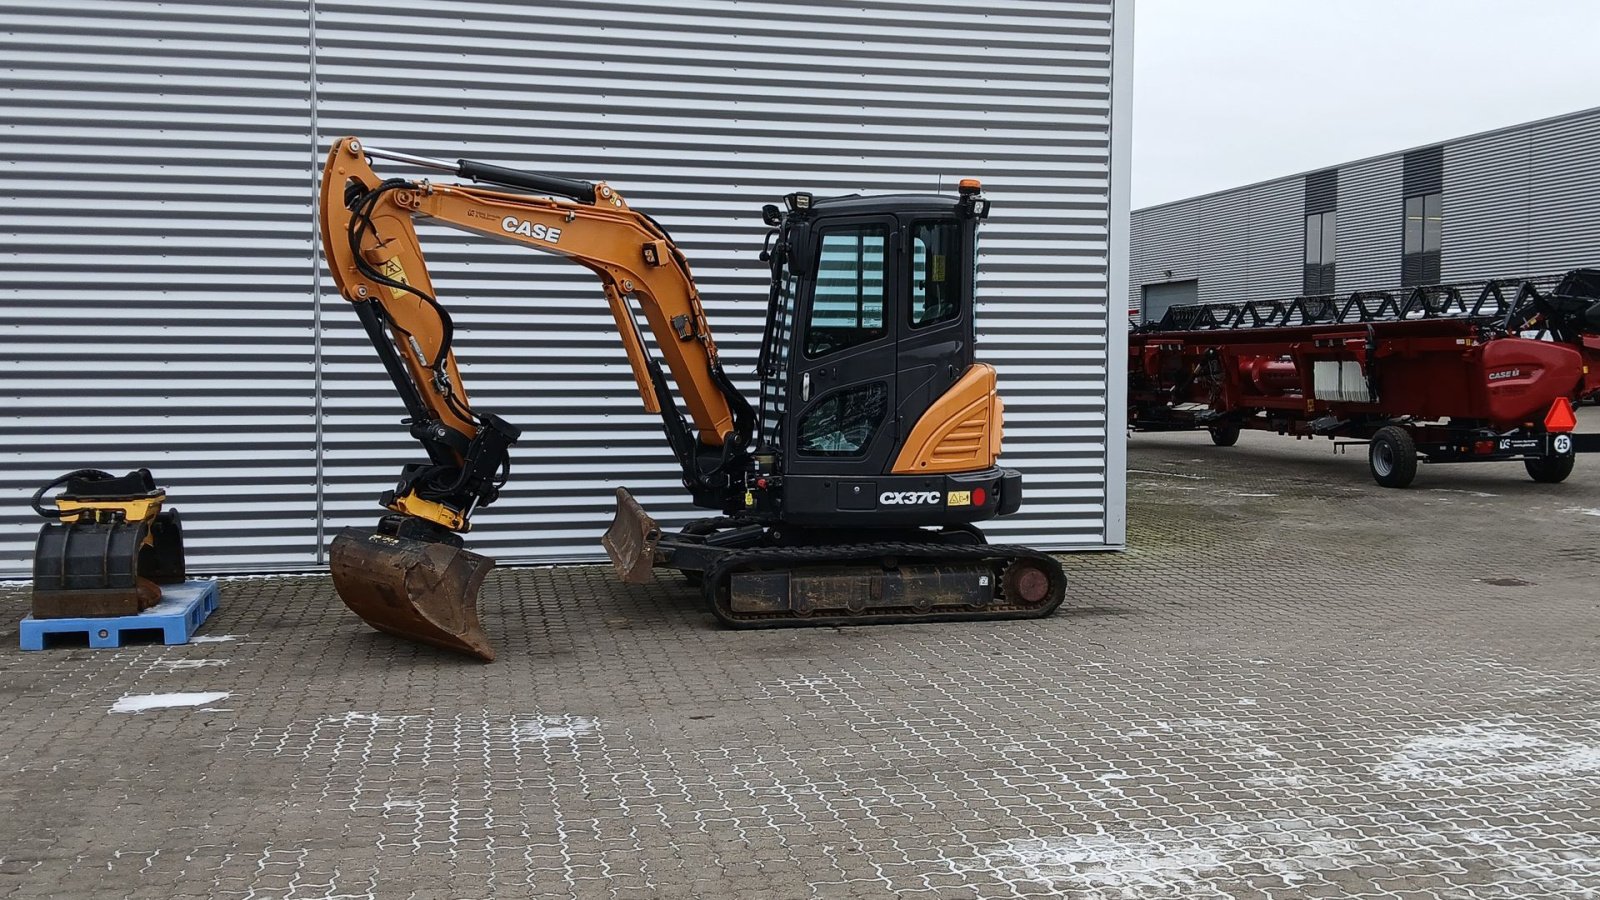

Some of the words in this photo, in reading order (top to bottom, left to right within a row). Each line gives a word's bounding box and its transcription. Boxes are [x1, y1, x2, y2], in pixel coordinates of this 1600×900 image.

[502, 216, 562, 243] CASE
[1489, 371, 1511, 379] CASE
[1557, 438, 1568, 449] 25
[880, 491, 940, 504] CX37C
